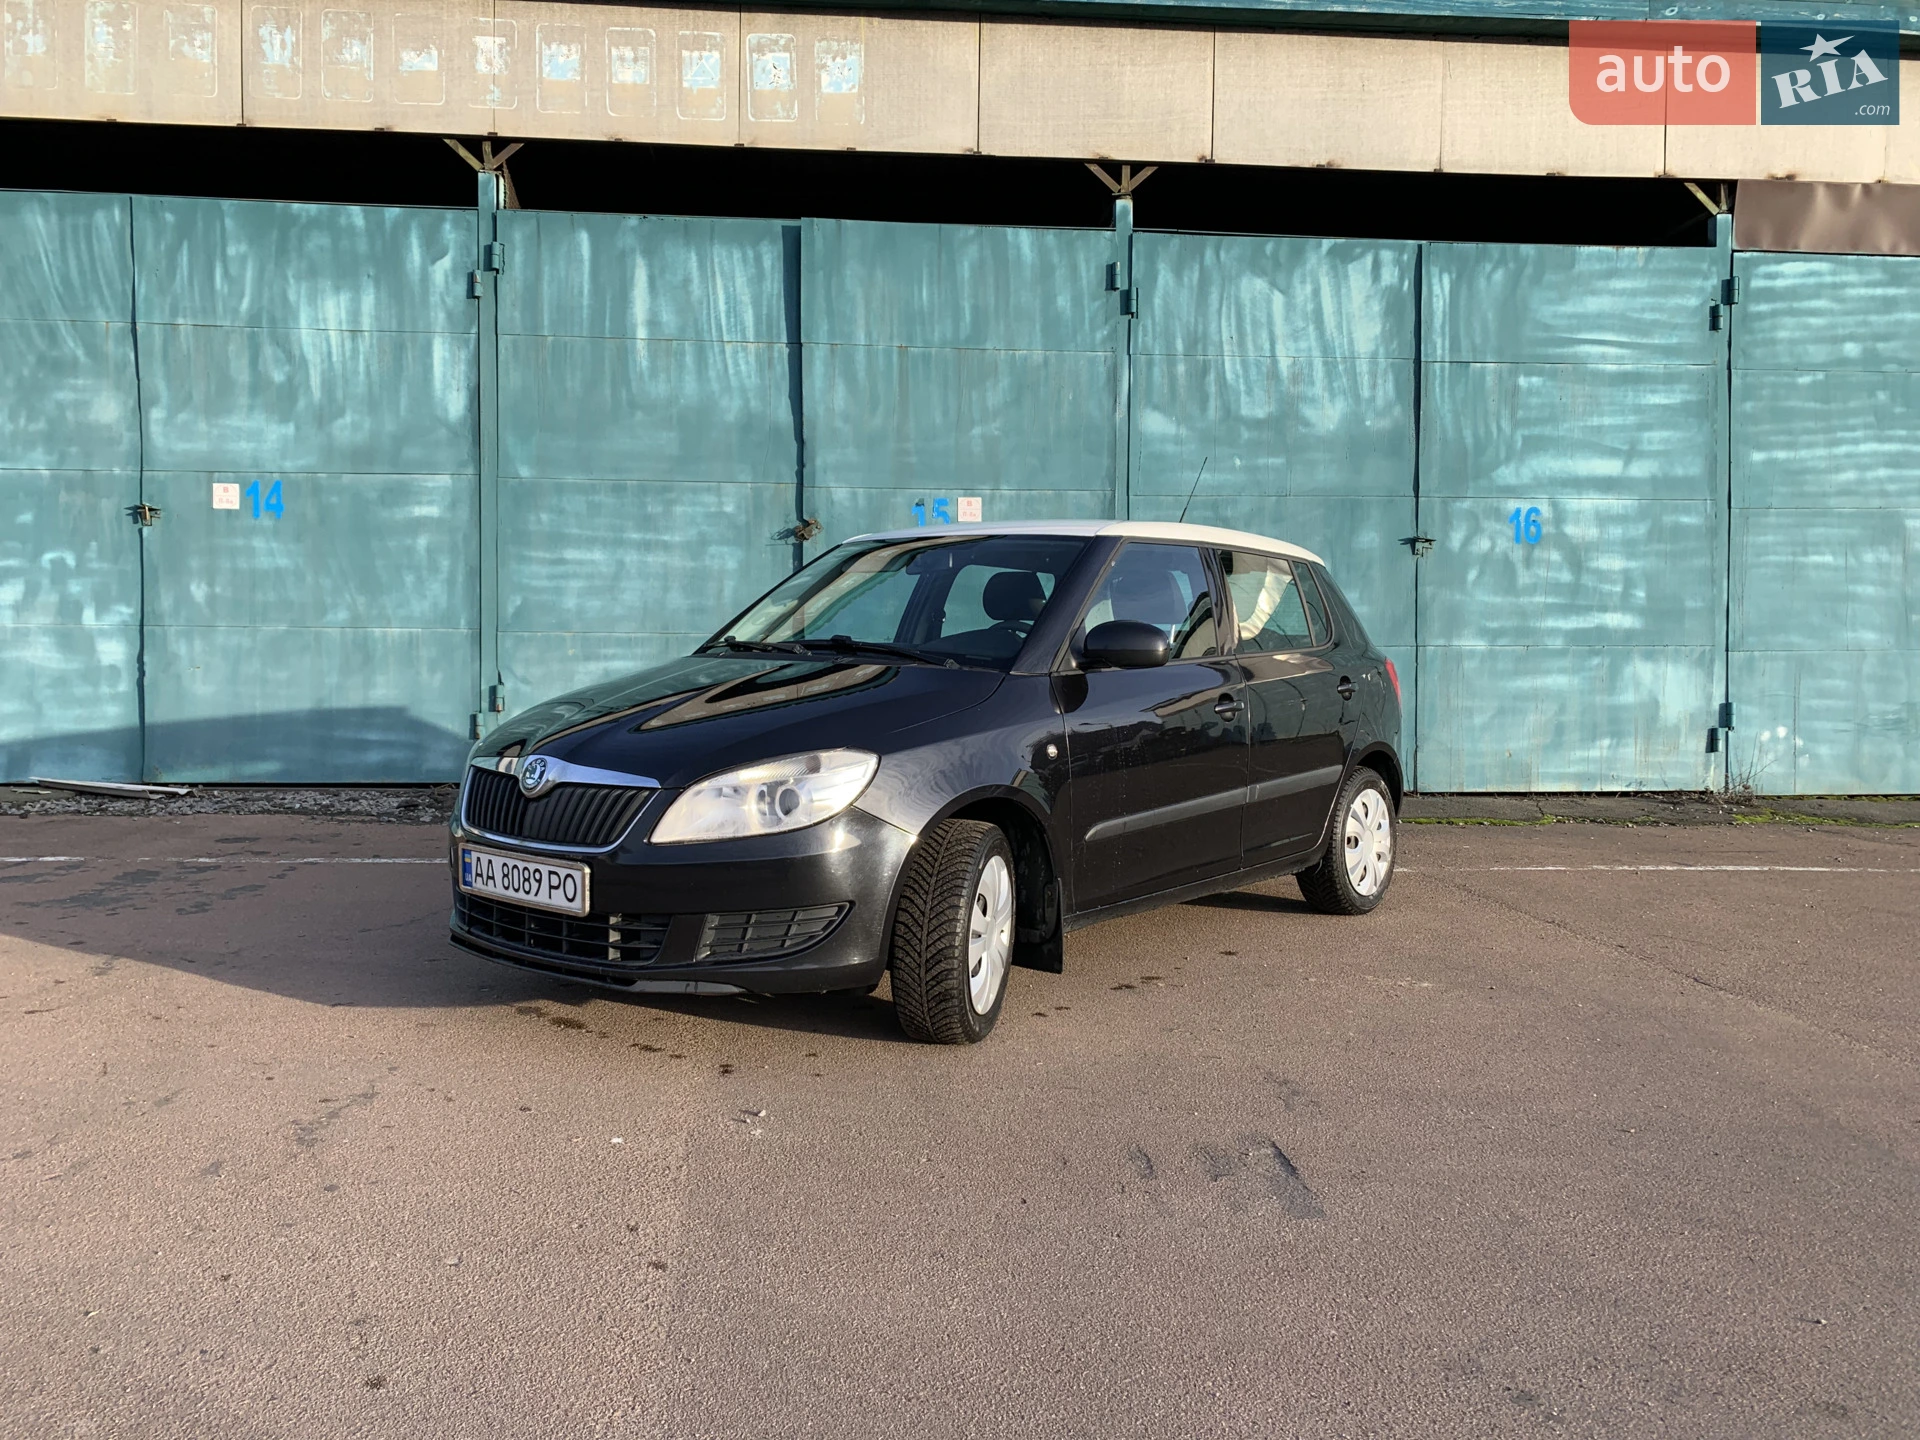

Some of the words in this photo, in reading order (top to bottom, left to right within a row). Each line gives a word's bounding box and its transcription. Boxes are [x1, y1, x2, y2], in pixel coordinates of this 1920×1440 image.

[245, 479, 285, 519] 14
[1508, 506, 1542, 545] 16
[474, 856, 497, 888] AA
[501, 862, 543, 897] 8089
[548, 870, 577, 903] PO
